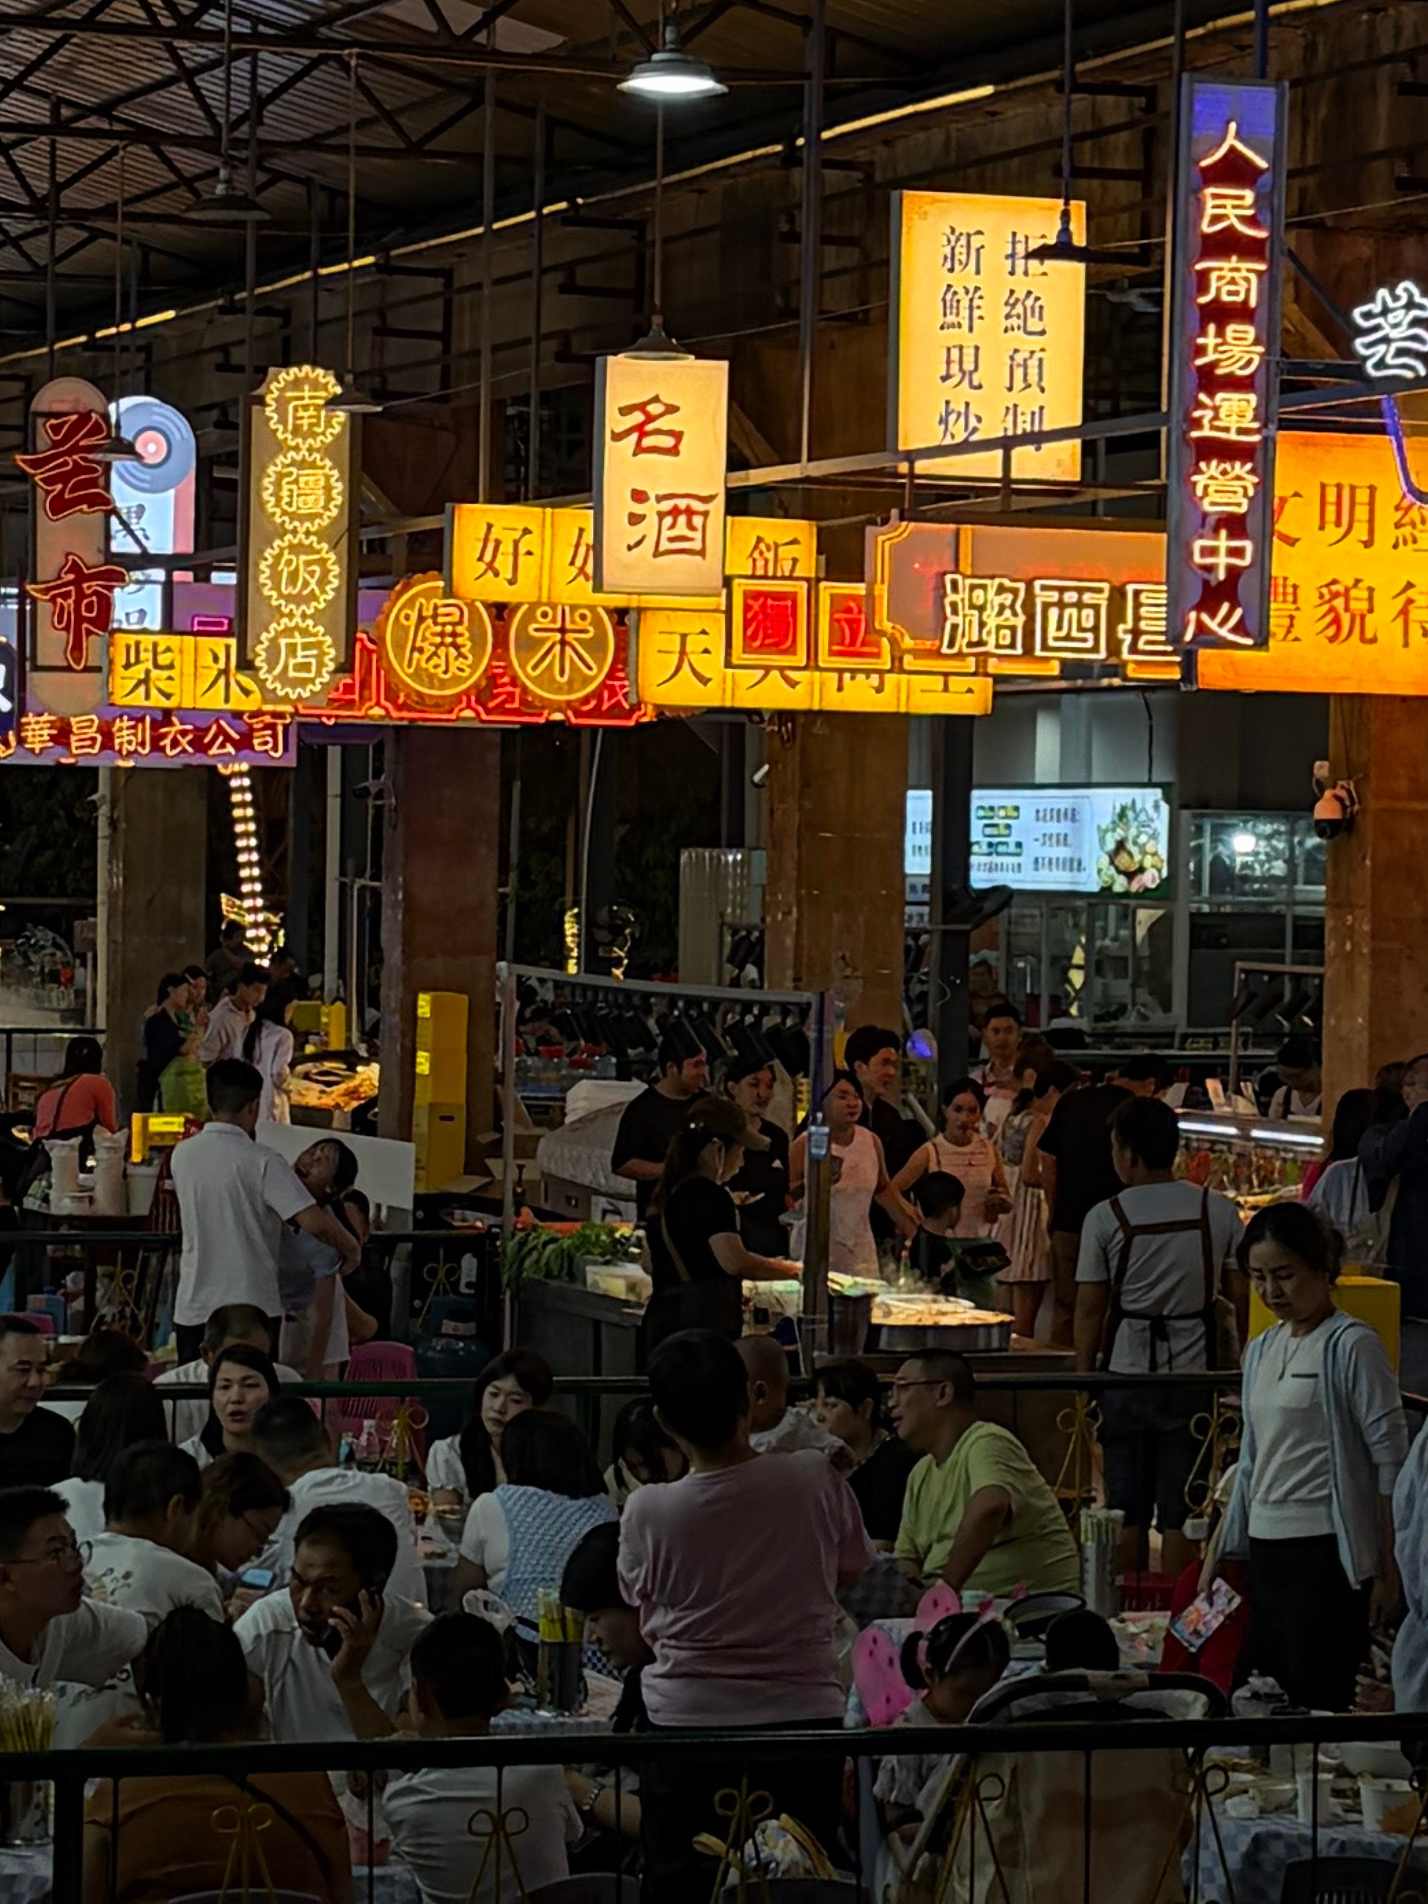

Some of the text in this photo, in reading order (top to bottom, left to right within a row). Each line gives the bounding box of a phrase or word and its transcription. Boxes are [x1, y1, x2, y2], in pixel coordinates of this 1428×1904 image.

[938, 224, 986, 444] 新鮮現炒
[1185, 120, 1269, 647] 人民商場運營中心
[275, 384, 328, 679] 南疆饭店
[610, 393, 720, 561] 名酒
[20, 712, 292, 759] 華昌制衣公司
